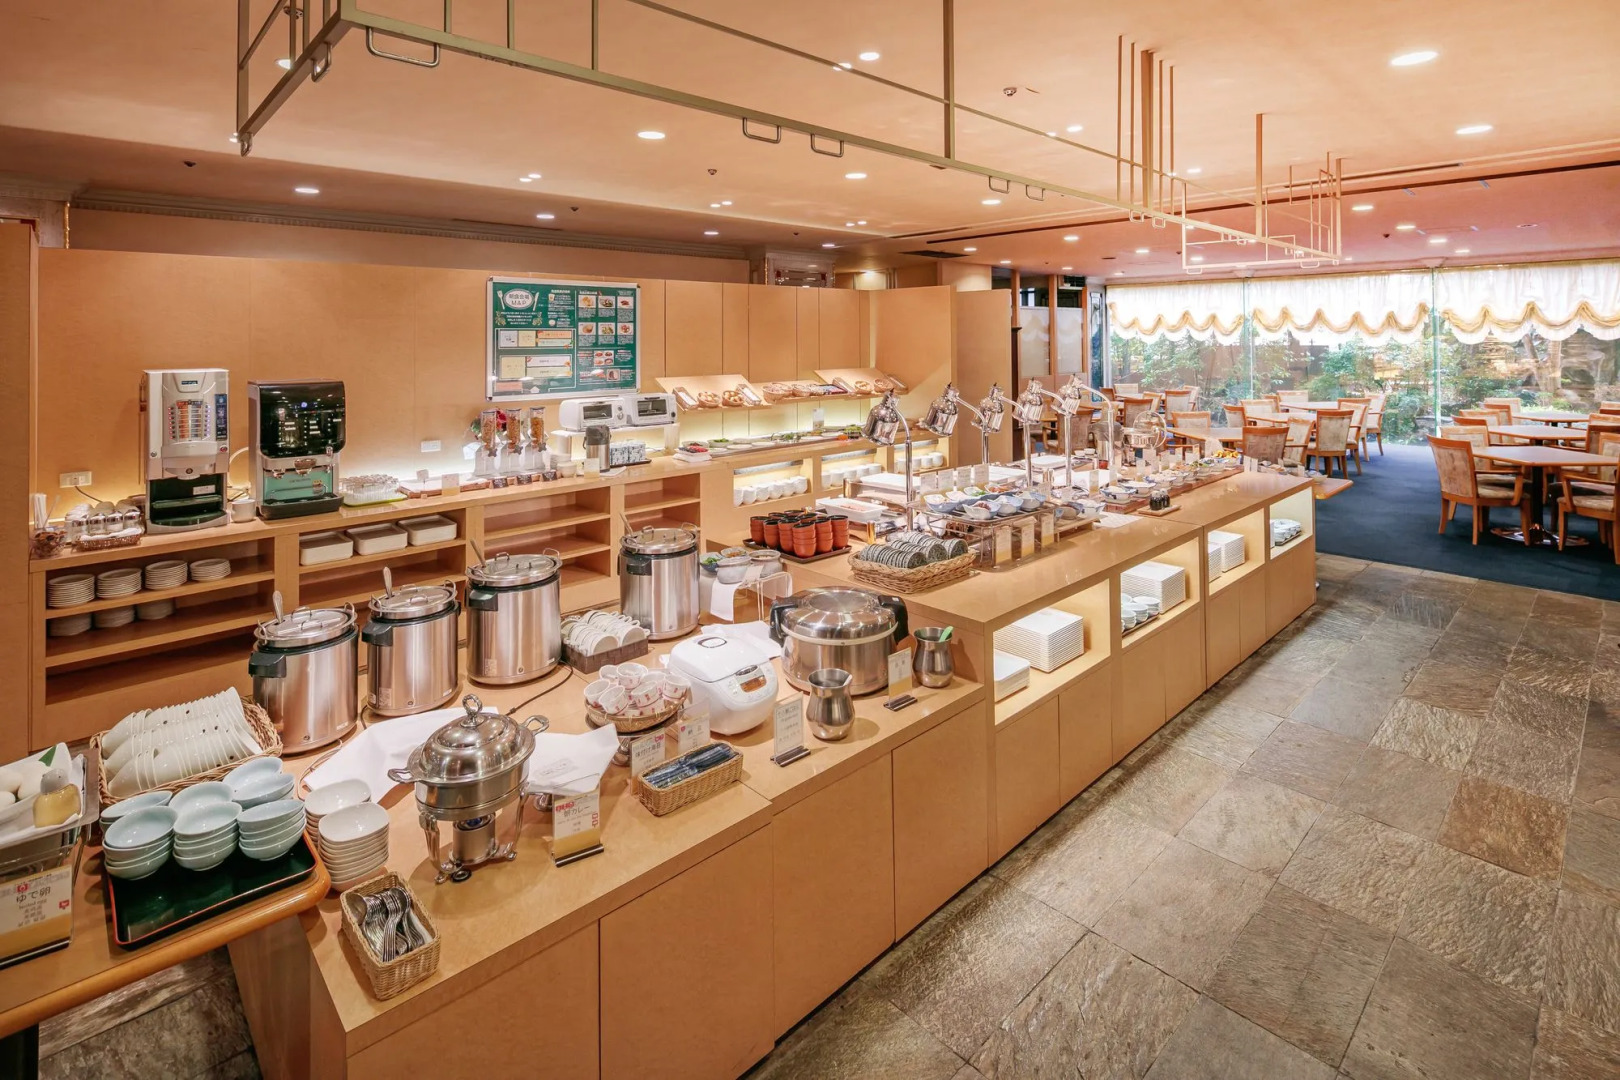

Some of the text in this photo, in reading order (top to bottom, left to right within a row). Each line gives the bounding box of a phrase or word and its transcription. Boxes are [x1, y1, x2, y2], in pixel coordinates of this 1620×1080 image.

[563, 805, 591, 817] 朝カレー
[16, 886, 51, 903] ゆで卵
